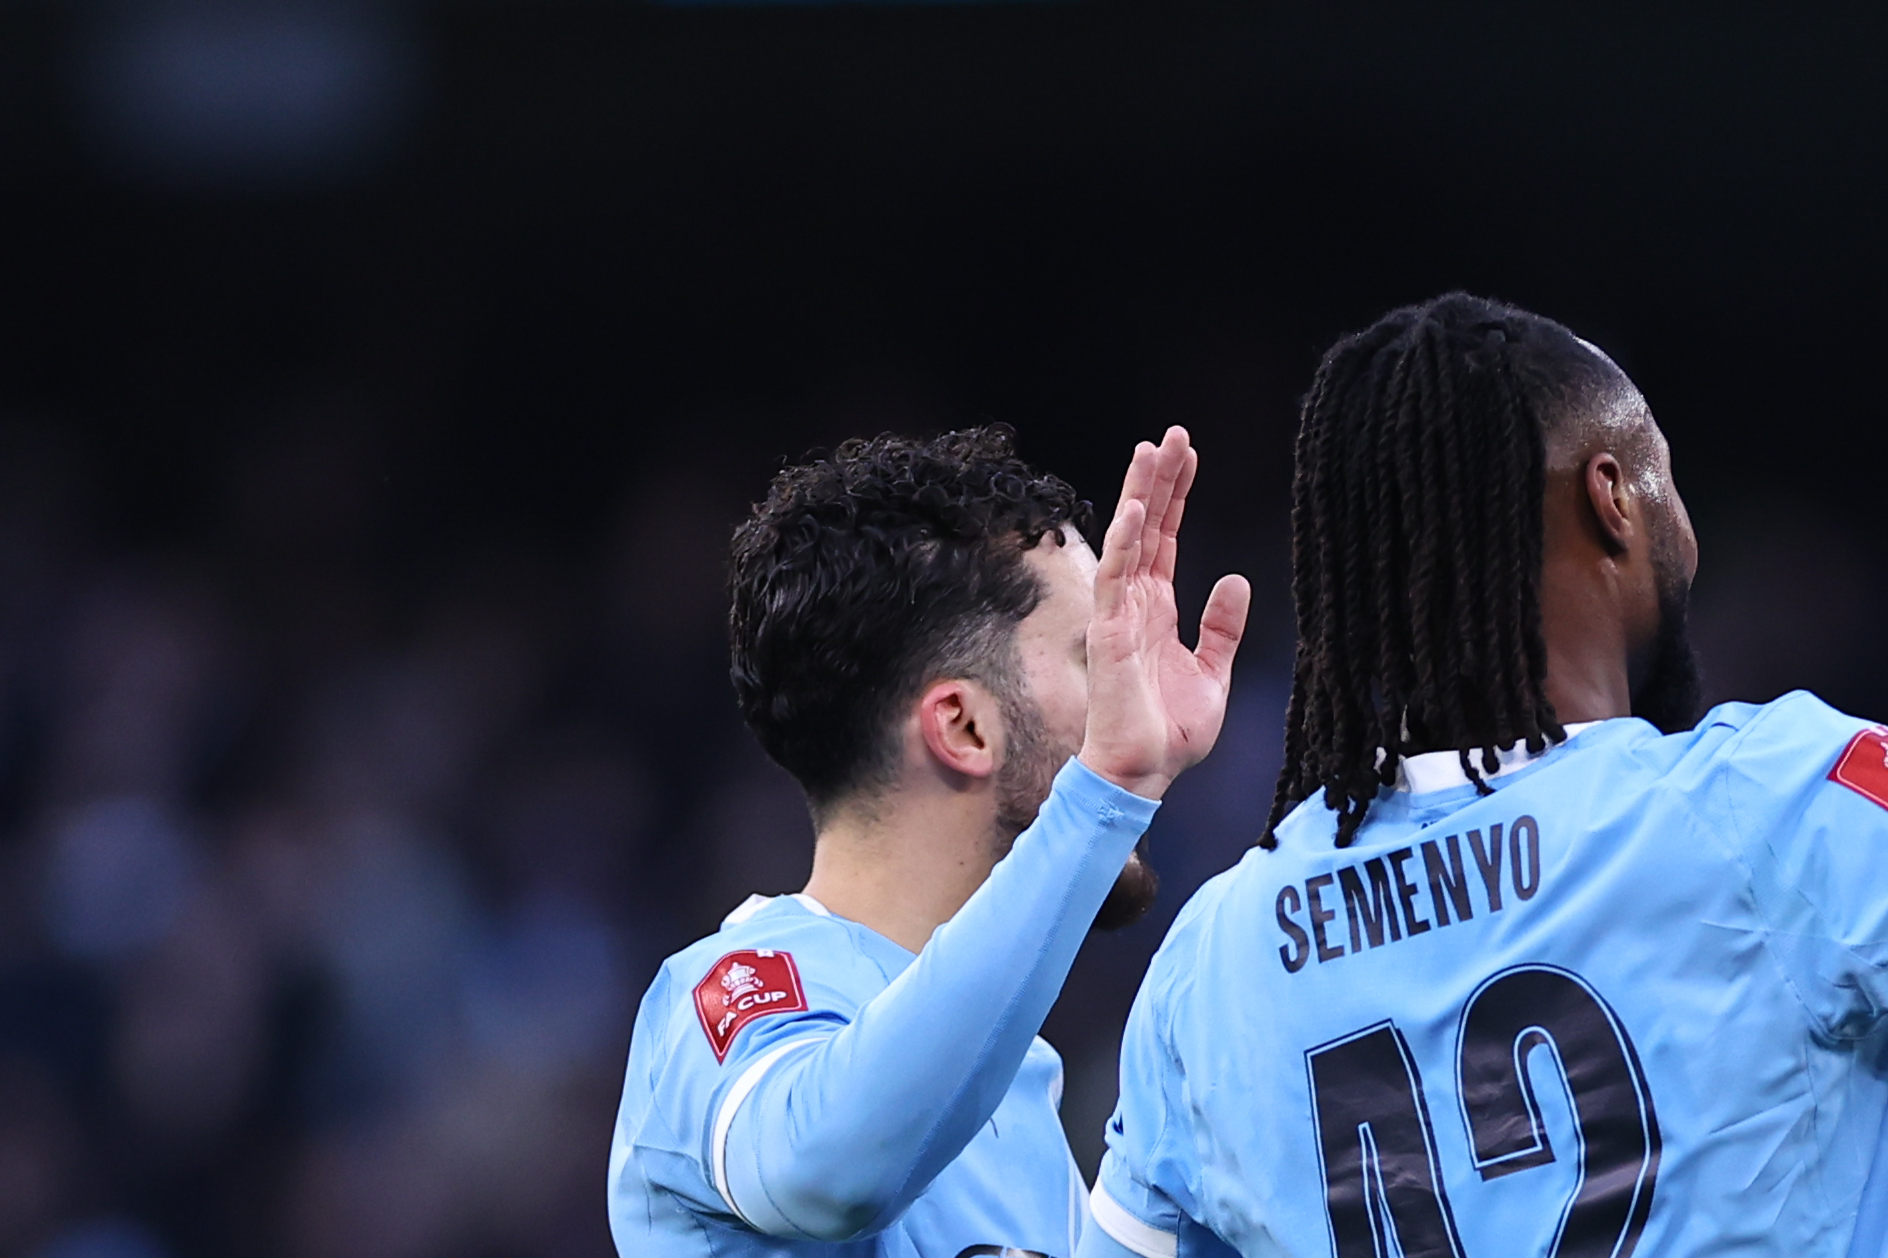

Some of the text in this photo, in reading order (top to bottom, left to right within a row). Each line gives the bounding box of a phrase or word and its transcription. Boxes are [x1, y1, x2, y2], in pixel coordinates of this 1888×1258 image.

[1275, 814, 1540, 974] SEMENYO
[717, 991, 787, 1037] FA CUP
